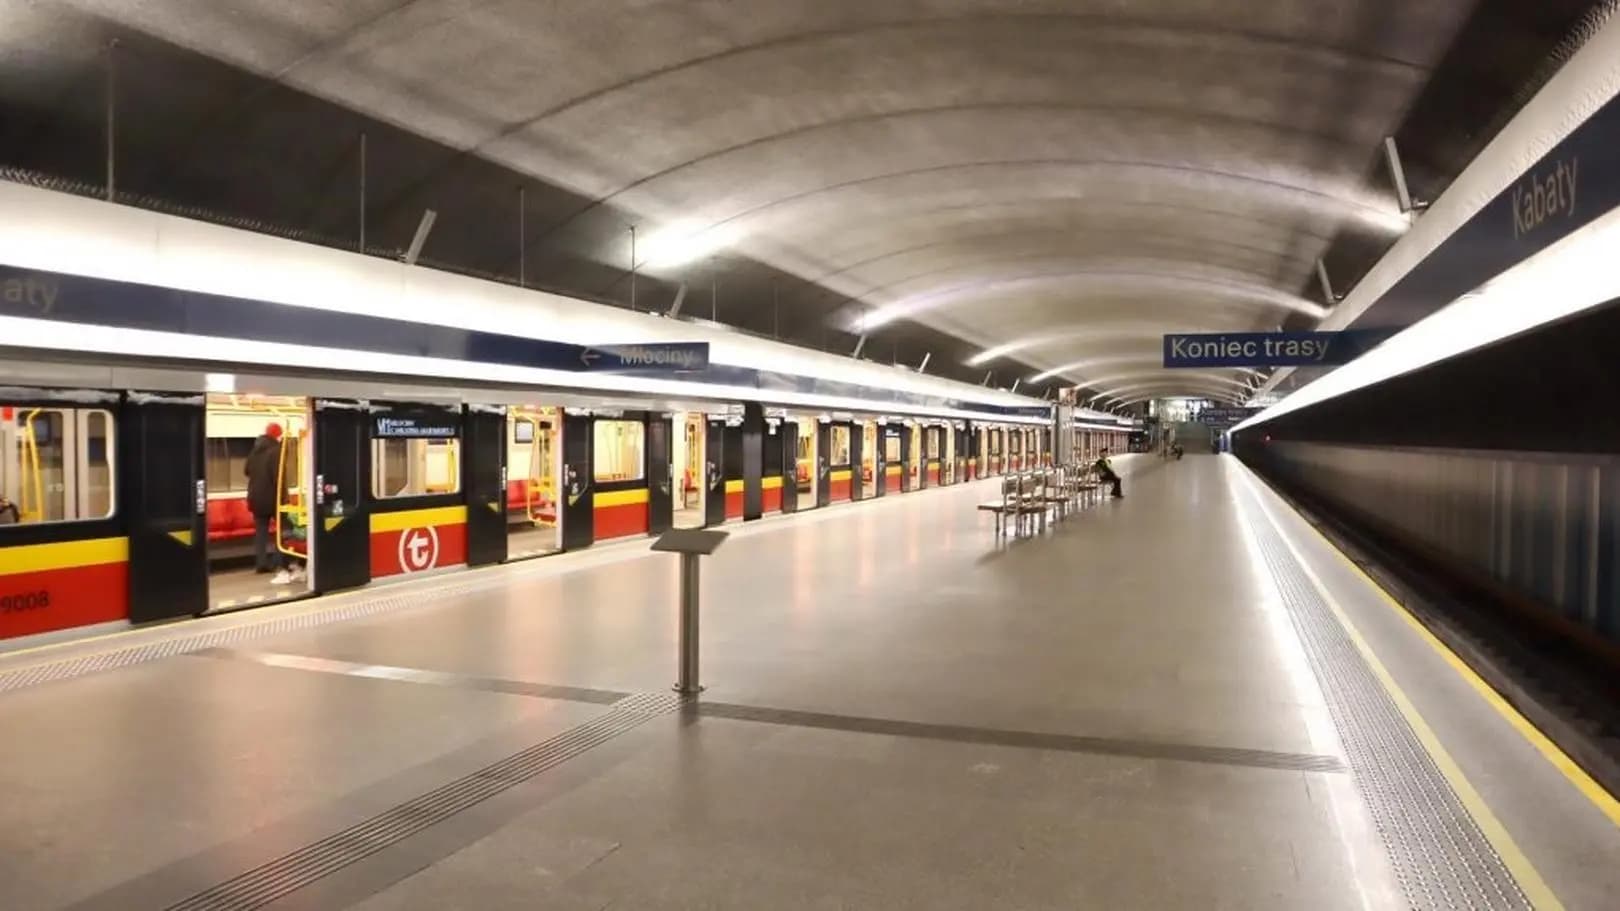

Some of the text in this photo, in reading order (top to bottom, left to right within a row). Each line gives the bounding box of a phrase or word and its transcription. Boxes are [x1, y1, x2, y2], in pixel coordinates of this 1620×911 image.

[1512, 157, 1578, 240] Kabaty
[1171, 336, 1329, 361] Koniec trasy
